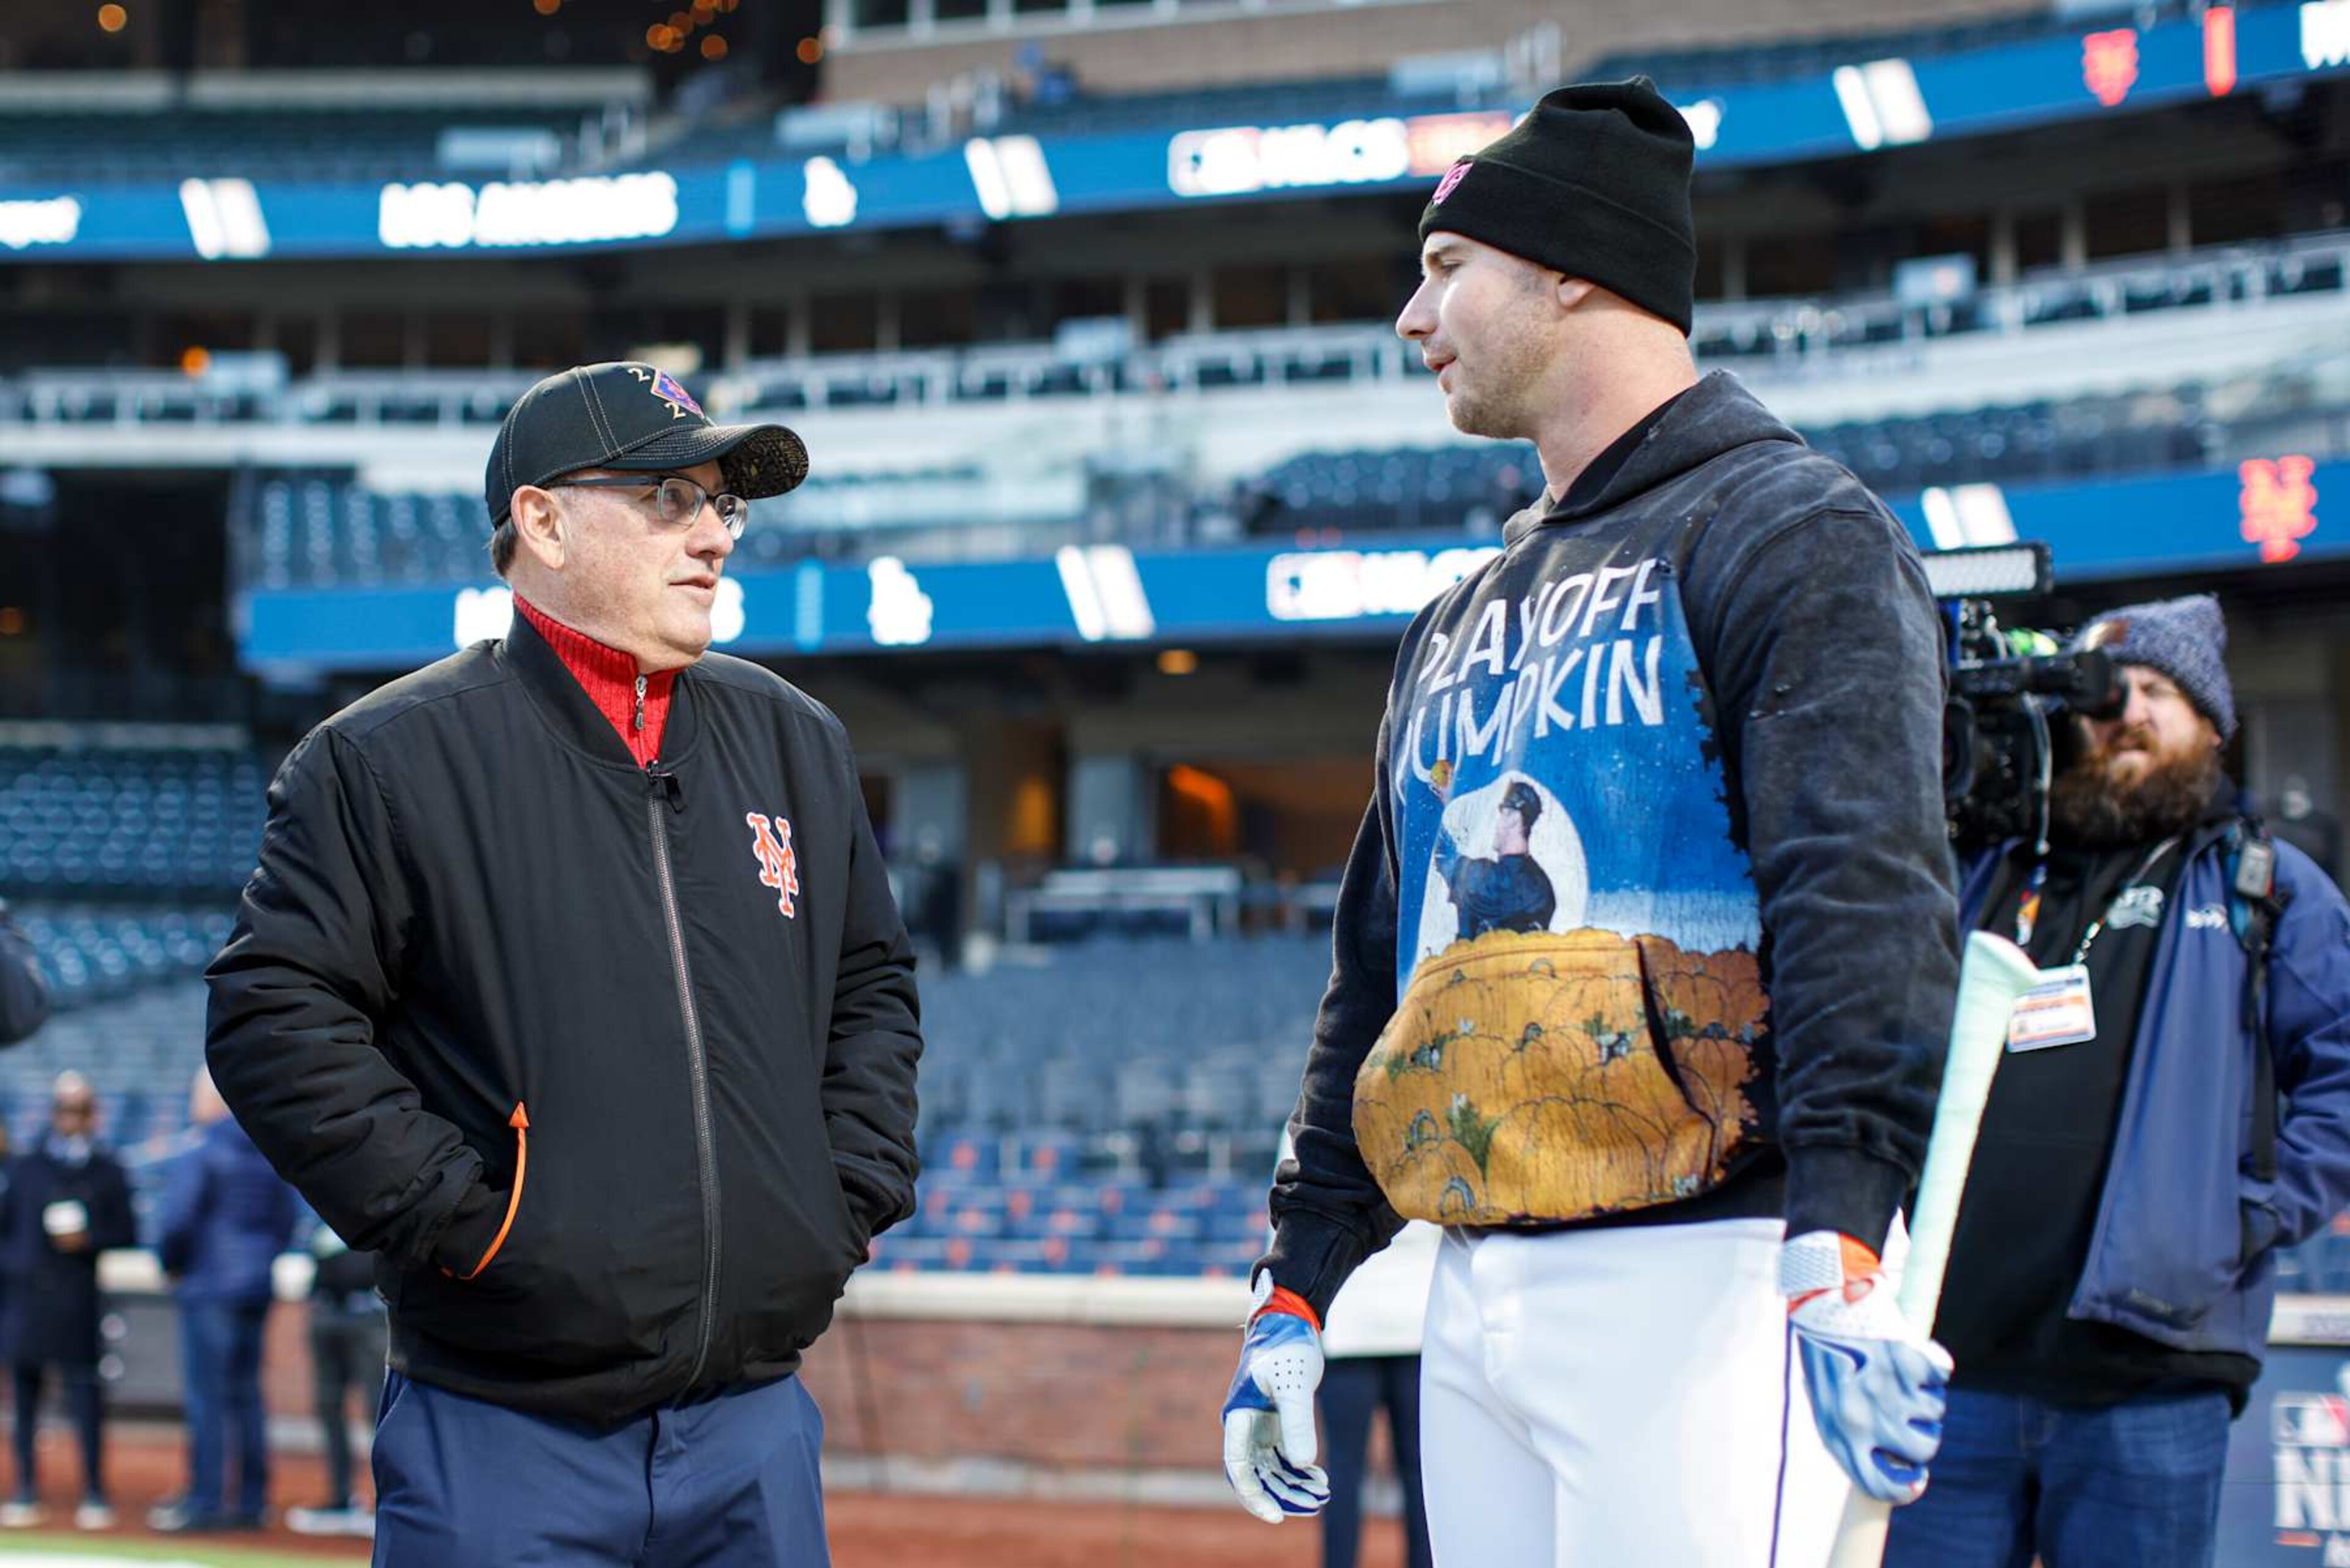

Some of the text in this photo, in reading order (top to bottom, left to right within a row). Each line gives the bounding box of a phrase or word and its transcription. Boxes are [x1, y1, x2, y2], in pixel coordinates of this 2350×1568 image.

[627, 367, 651, 382] 2
[664, 402, 686, 420] 2
[1395, 635, 1664, 807] UMPKIN
[747, 812, 799, 919] NY
